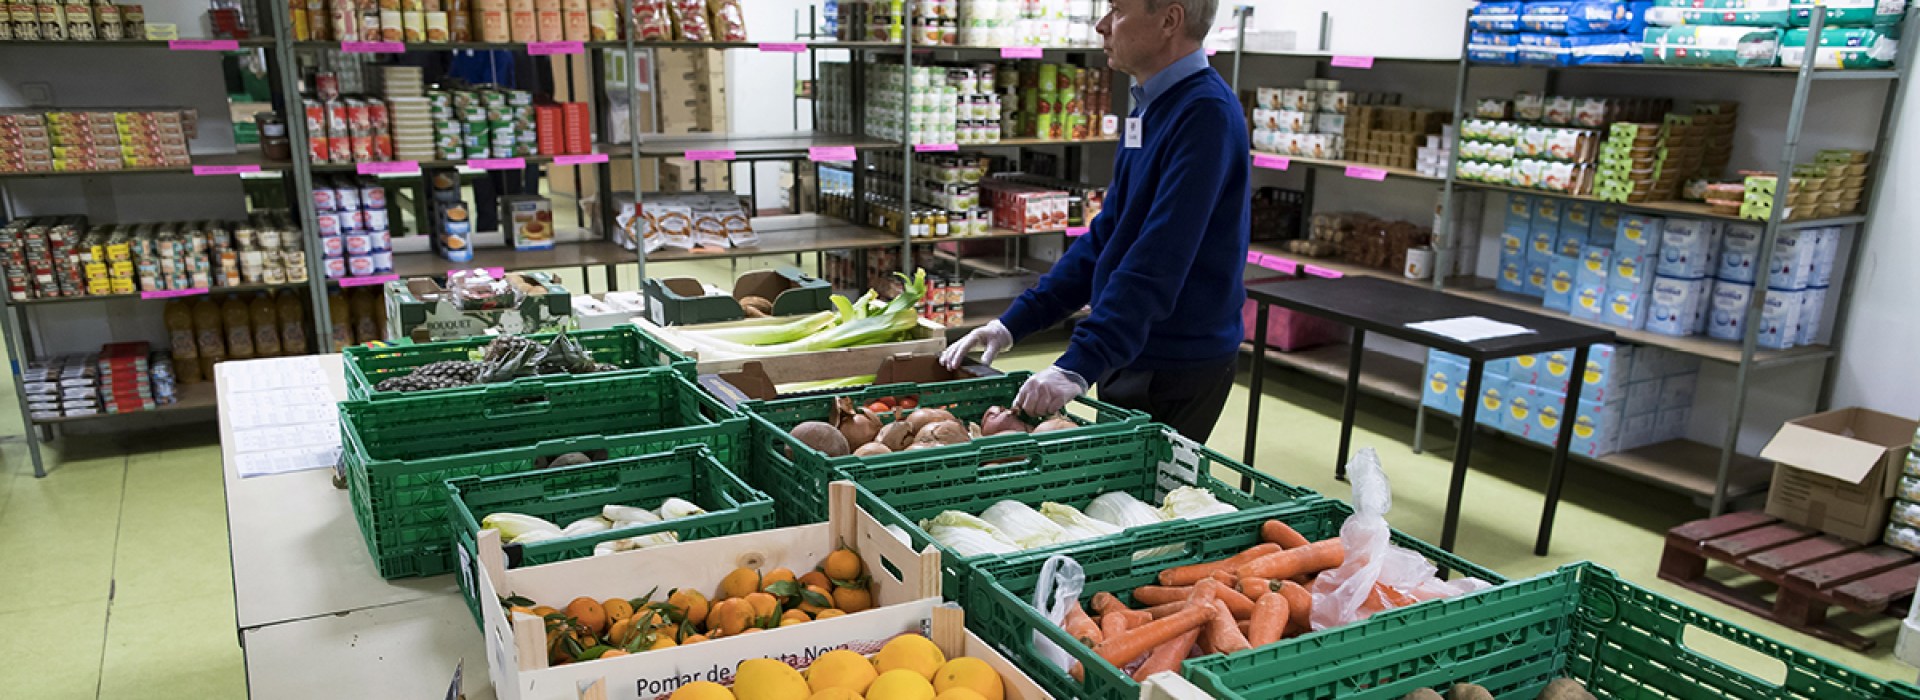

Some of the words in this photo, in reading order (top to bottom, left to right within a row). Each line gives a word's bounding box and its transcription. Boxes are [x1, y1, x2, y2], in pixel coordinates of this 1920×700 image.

[427, 319, 472, 330] BOUQUET
[1596, 388, 1604, 402] 2
[1523, 424, 1530, 437] 2
[1588, 442, 1596, 455] 2
[636, 671, 701, 697] Pomar
[706, 664, 731, 682] de
